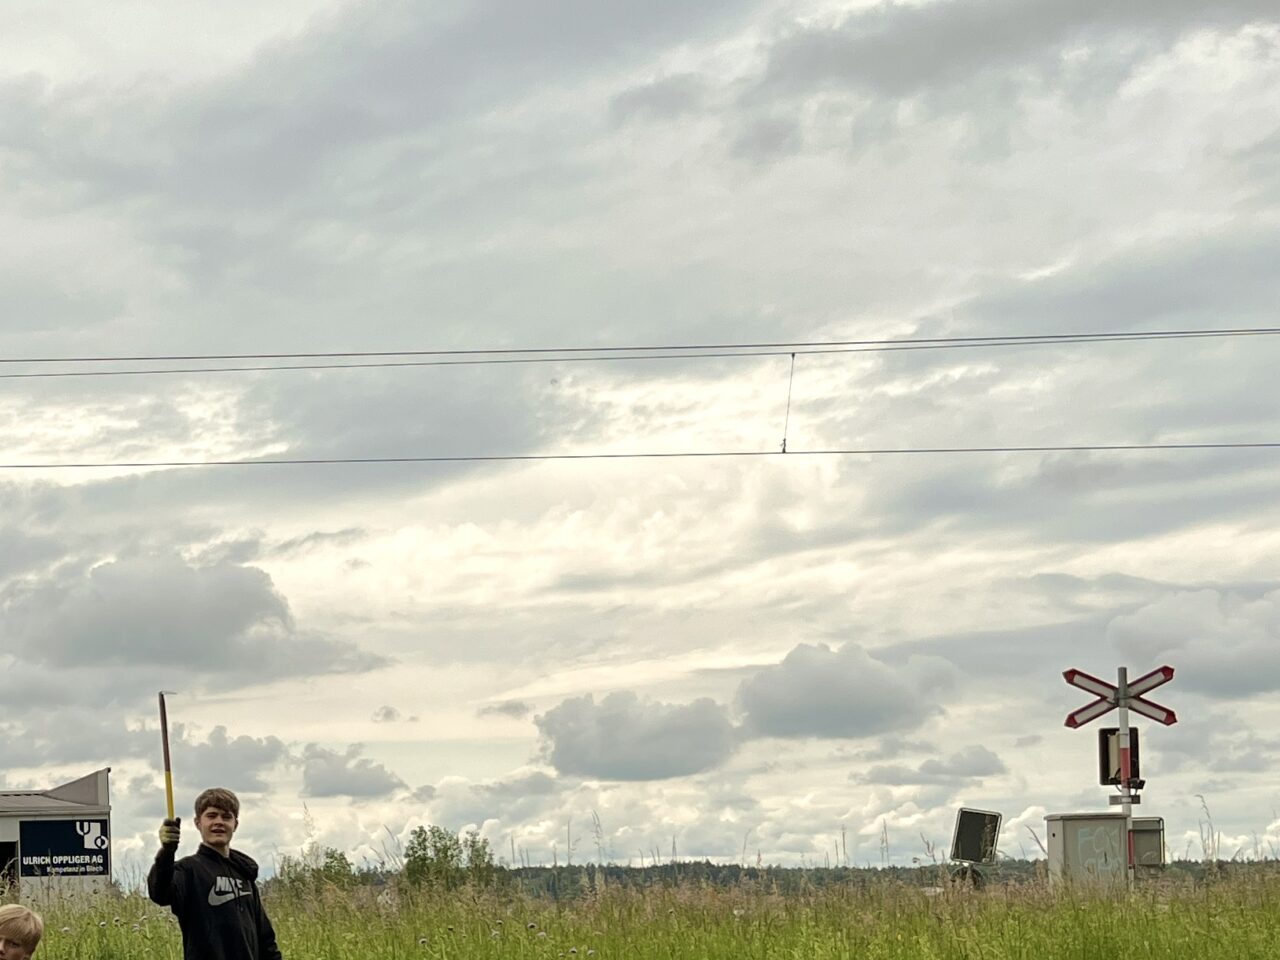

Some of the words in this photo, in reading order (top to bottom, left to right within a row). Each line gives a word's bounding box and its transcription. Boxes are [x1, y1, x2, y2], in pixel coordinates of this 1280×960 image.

[23, 856, 51, 865] ULRICH
[52, 855, 91, 864] OPPLIGER
[91, 855, 103, 864] AG
